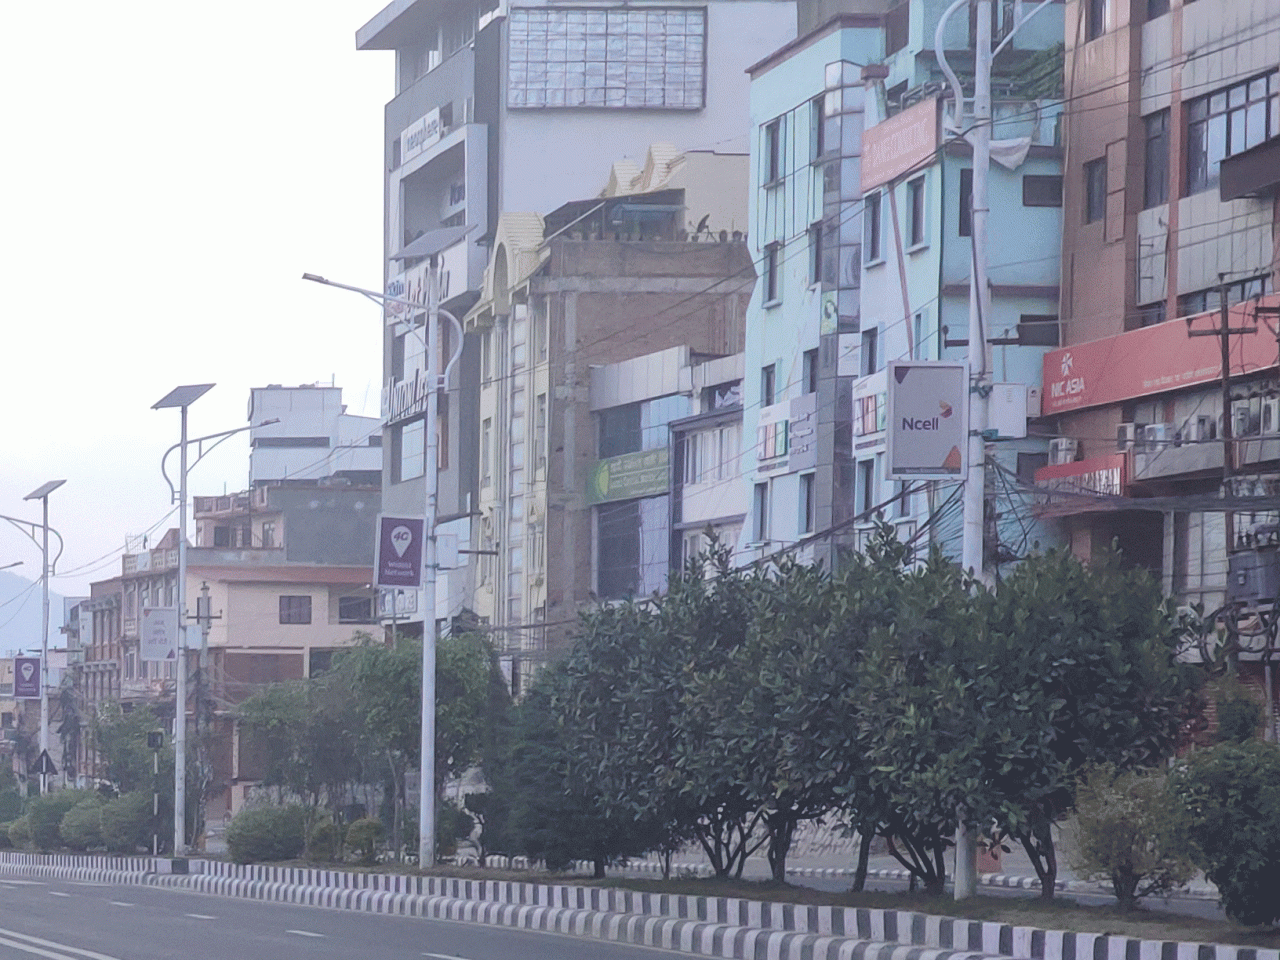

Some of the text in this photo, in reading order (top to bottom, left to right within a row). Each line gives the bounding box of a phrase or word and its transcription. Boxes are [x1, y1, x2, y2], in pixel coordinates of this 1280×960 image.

[1051, 377, 1085, 398] NIC ASIA
[902, 417, 939, 431] Ncell
[394, 531, 410, 541] 4G
